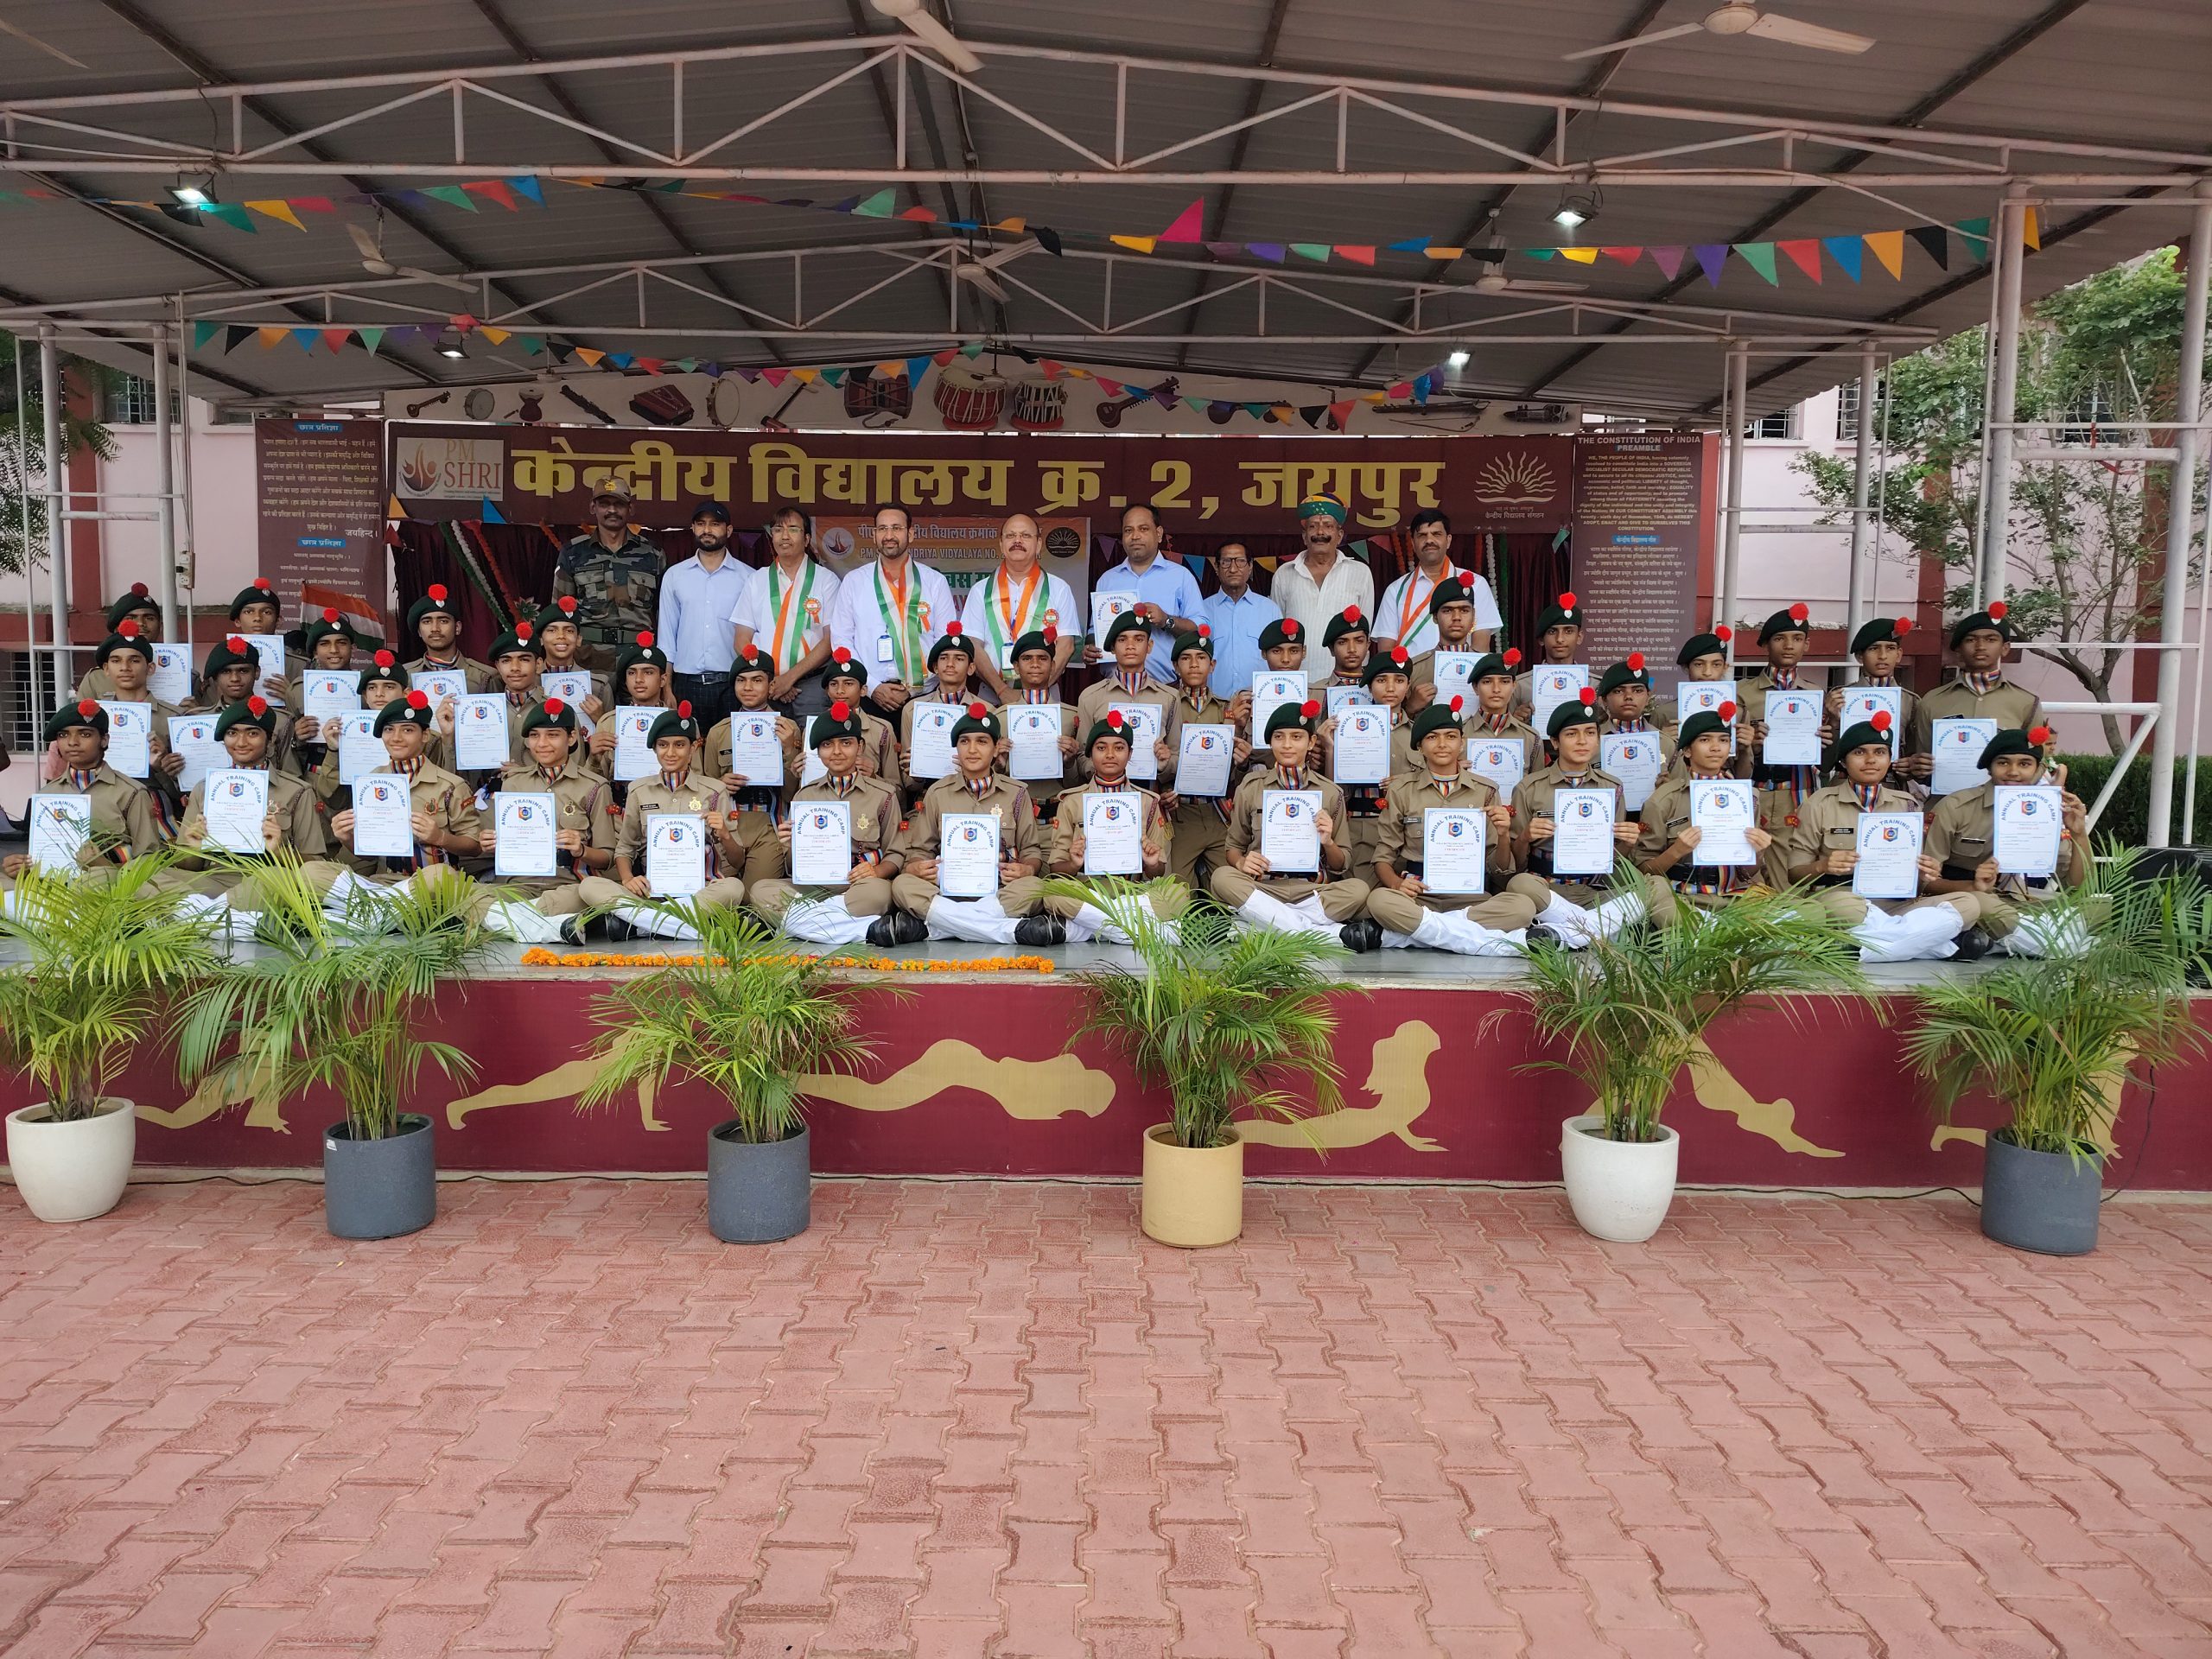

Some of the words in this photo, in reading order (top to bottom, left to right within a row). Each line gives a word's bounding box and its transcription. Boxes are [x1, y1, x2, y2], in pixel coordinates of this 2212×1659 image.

[445, 439, 476, 461] PM
[444, 461, 501, 489] SHRI
[748, 442, 1014, 506] विद्यालय
[1239, 461, 1446, 528] जयपुर
[319, 538, 341, 547] प्रतिज्ञा
[930, 524, 967, 539] विद्यालय
[969, 524, 998, 540] क्रमांक
[860, 548, 874, 558] PM
[908, 548, 938, 559] NDRIYA
[940, 548, 982, 559] VIDYALAYA
[985, 548, 999, 559] NO.
[1098, 601, 1107, 620] ANNUAL
[1107, 595, 1130, 604] TRAINING
[1538, 675, 1550, 695] ANNUAL
[1550, 670, 1576, 680] TRAINING
[461, 702, 472, 724] ANNUAL
[471, 699, 496, 709] TRAINING
[1683, 692, 1696, 712] ANNUAL
[1696, 688, 1724, 696] TRAINING
[620, 716, 632, 735] ANNUAL
[1125, 709, 1150, 720] TRAINING
[1340, 715, 1352, 736] ANNUAL
[1352, 711, 1379, 721] TRAINING
[736, 722, 747, 741] ANNUAL
[747, 717, 771, 727] TRAINING
[1185, 734, 1198, 753] ANNUAL
[1198, 729, 1224, 740] TRAINING
[1472, 749, 1485, 770] ANNUAL
[1486, 745, 1512, 755] TRAINING
[1607, 745, 1619, 766] ANNUAL
[1619, 739, 1648, 747] TRAINING
[211, 780, 226, 801] ANNUAL
[226, 775, 255, 786] TRAINING
[359, 784, 370, 805] ANNUAL
[370, 779, 397, 791] TRAINING
[1697, 791, 1710, 814] ANNUAL
[1710, 786, 1739, 797] TRAINING
[1738, 797, 1747, 814] CAMP
[501, 804, 514, 825] ANNUAL
[513, 799, 542, 810] TRAINING
[1090, 804, 1102, 826] ANNUAL
[1102, 798, 1129, 809] TRAINING
[1268, 801, 1281, 823] ANNUAL
[1282, 796, 1310, 807] TRAINING
[1560, 800, 1574, 823] ANNUAL
[1574, 795, 1603, 806] TRAINING
[2001, 798, 2017, 821] ANNUAL
[2017, 792, 2049, 804] TRAINING
[2048, 804, 2056, 821] CAMP
[653, 826, 665, 848] ANNUAL
[665, 820, 692, 831] TRAINING
[797, 812, 810, 835] ANNUAL
[810, 807, 838, 818] TRAINING
[947, 825, 960, 847] ANNUAL
[960, 820, 987, 831] TRAINING
[1430, 820, 1444, 842] ANNUAL
[1445, 815, 1473, 825] TRAINING
[1863, 824, 1878, 848] ANNUAL
[1879, 819, 1910, 830] TRAINING
